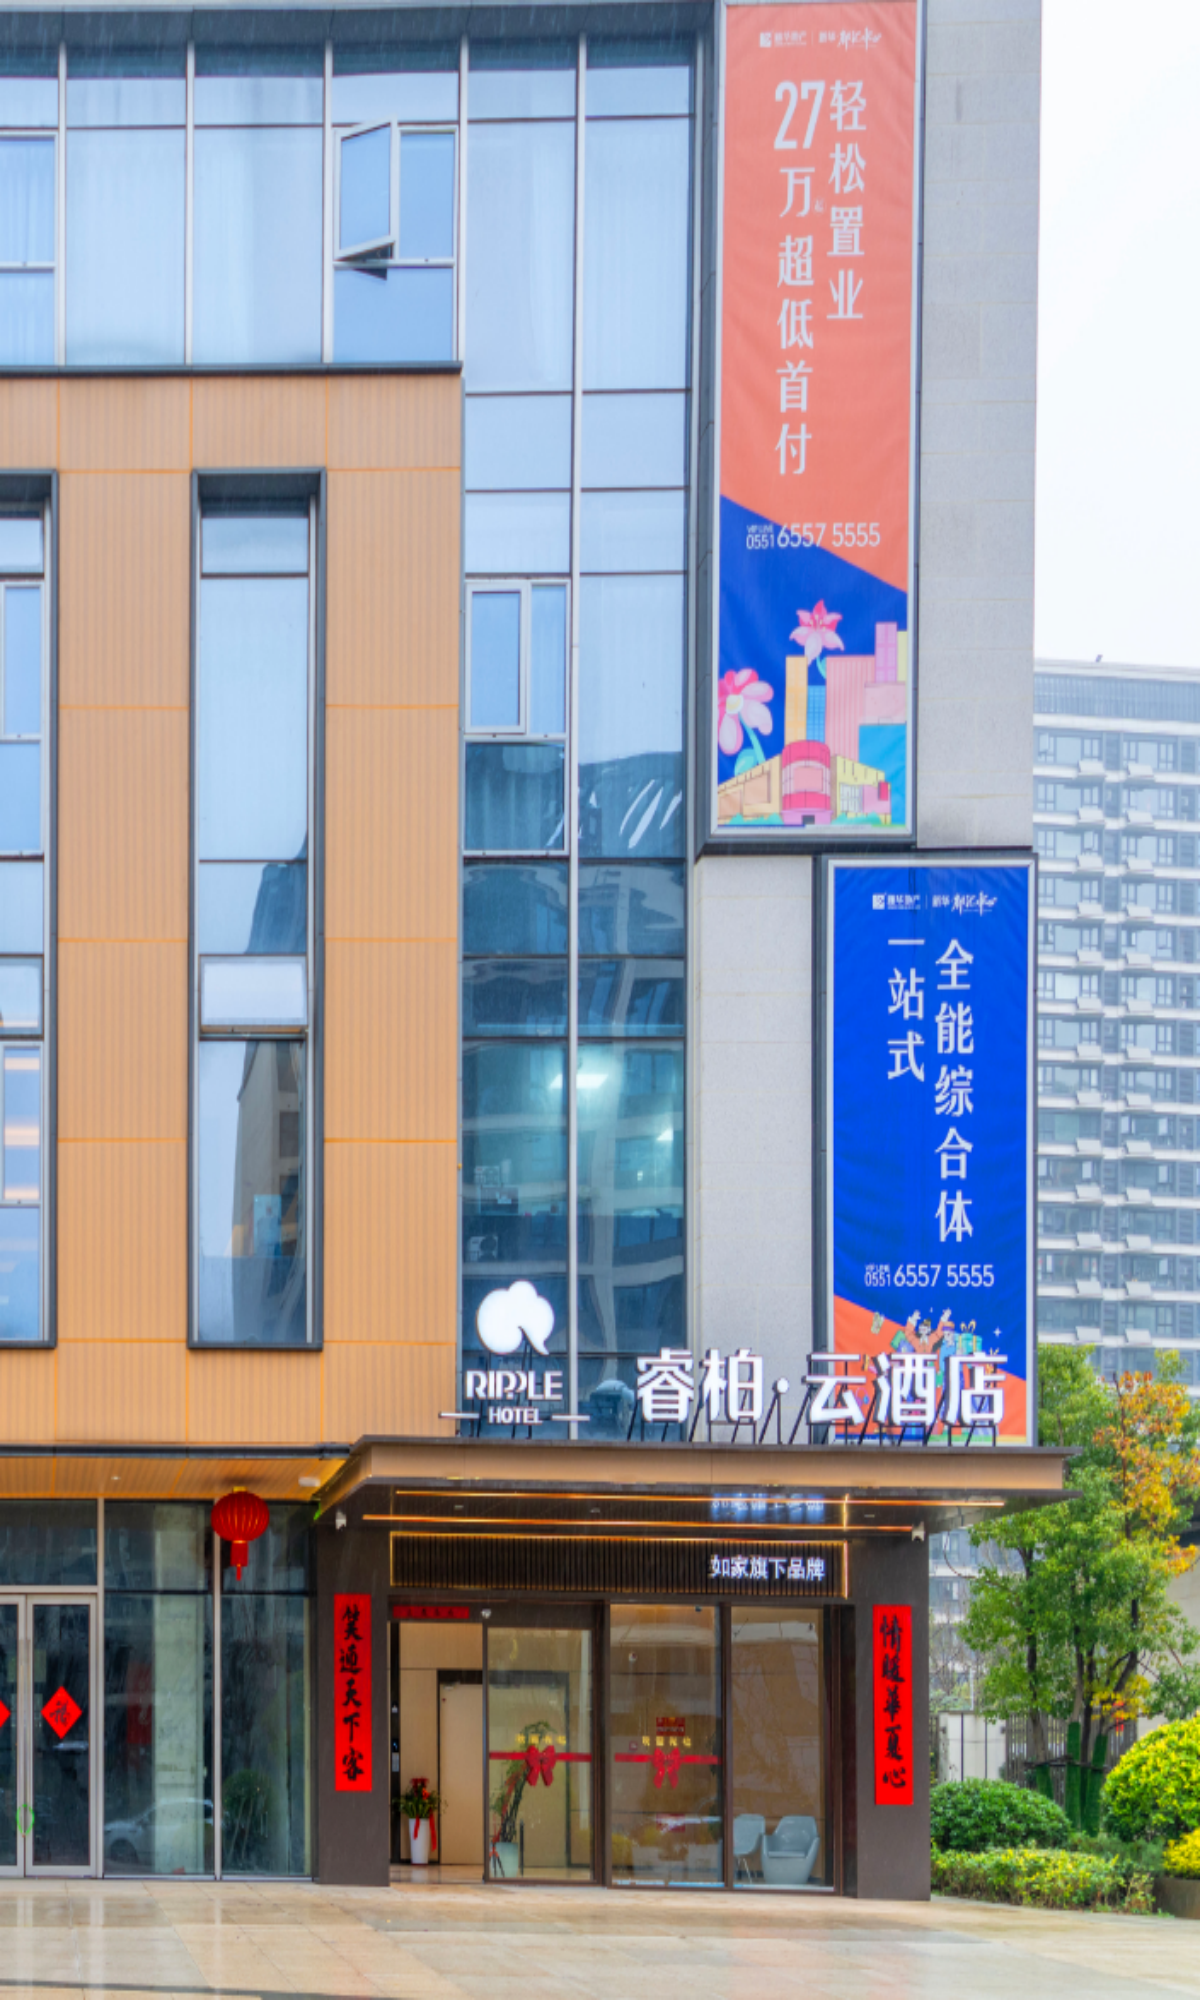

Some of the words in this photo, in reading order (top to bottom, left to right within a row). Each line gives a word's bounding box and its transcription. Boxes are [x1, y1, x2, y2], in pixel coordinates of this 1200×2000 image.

[826, 79, 867, 320] 轻松置业
[746, 534, 775, 549] 0551
[777, 522, 827, 548] 6557
[831, 522, 881, 548] 5555
[887, 938, 926, 1082] 一站式
[934, 938, 975, 1243] 全能综合体
[864, 1272, 891, 1288] 0551
[893, 1264, 942, 1288] 6557
[946, 1264, 995, 1288] 5555
[465, 1370, 563, 1400] RIPPLE
[635, 1346, 1009, 1426] 睿柏·云酒店
[488, 1406, 543, 1425] HOTEL
[709, 1554, 826, 1582] 如家旗下品牌
